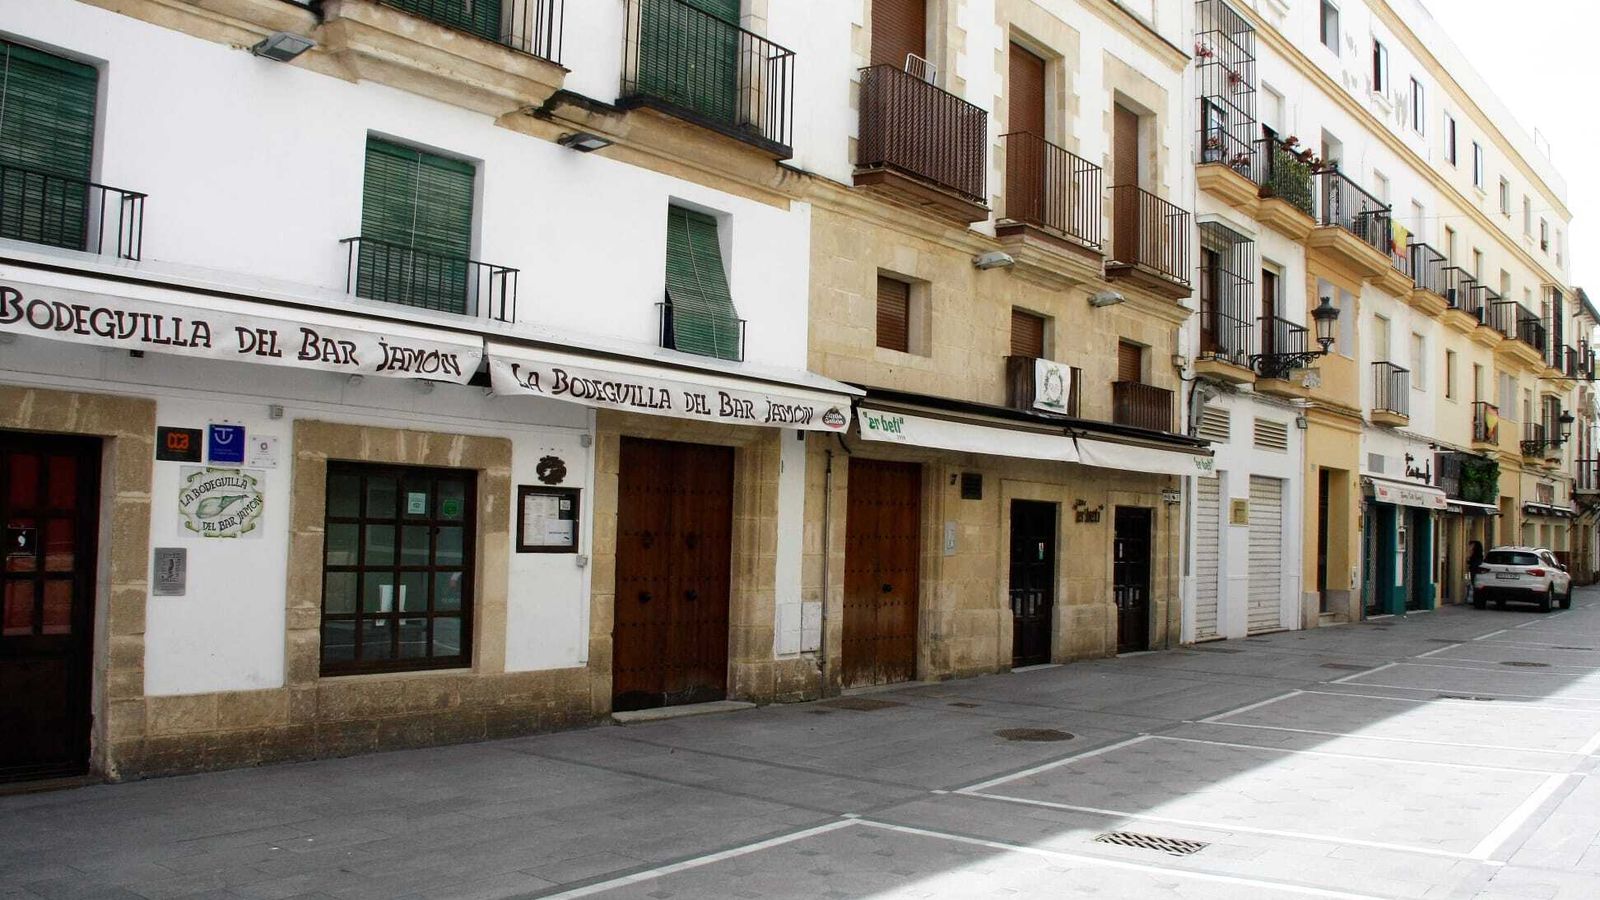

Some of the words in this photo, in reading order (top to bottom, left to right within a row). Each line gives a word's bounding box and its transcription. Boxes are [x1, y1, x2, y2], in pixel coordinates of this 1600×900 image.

[0, 286, 211, 348] BODEGUILLA
[235, 326, 282, 358] DEL
[298, 327, 360, 366] BAR
[552, 368, 672, 410] BODEGUILLA
[683, 391, 711, 416] DEL
[718, 391, 756, 420] BAR
[180, 493, 194, 507] LA
[191, 476, 248, 500] BODEGUILLA
[203, 521, 217, 531] DEL
[218, 516, 239, 532] BAR
